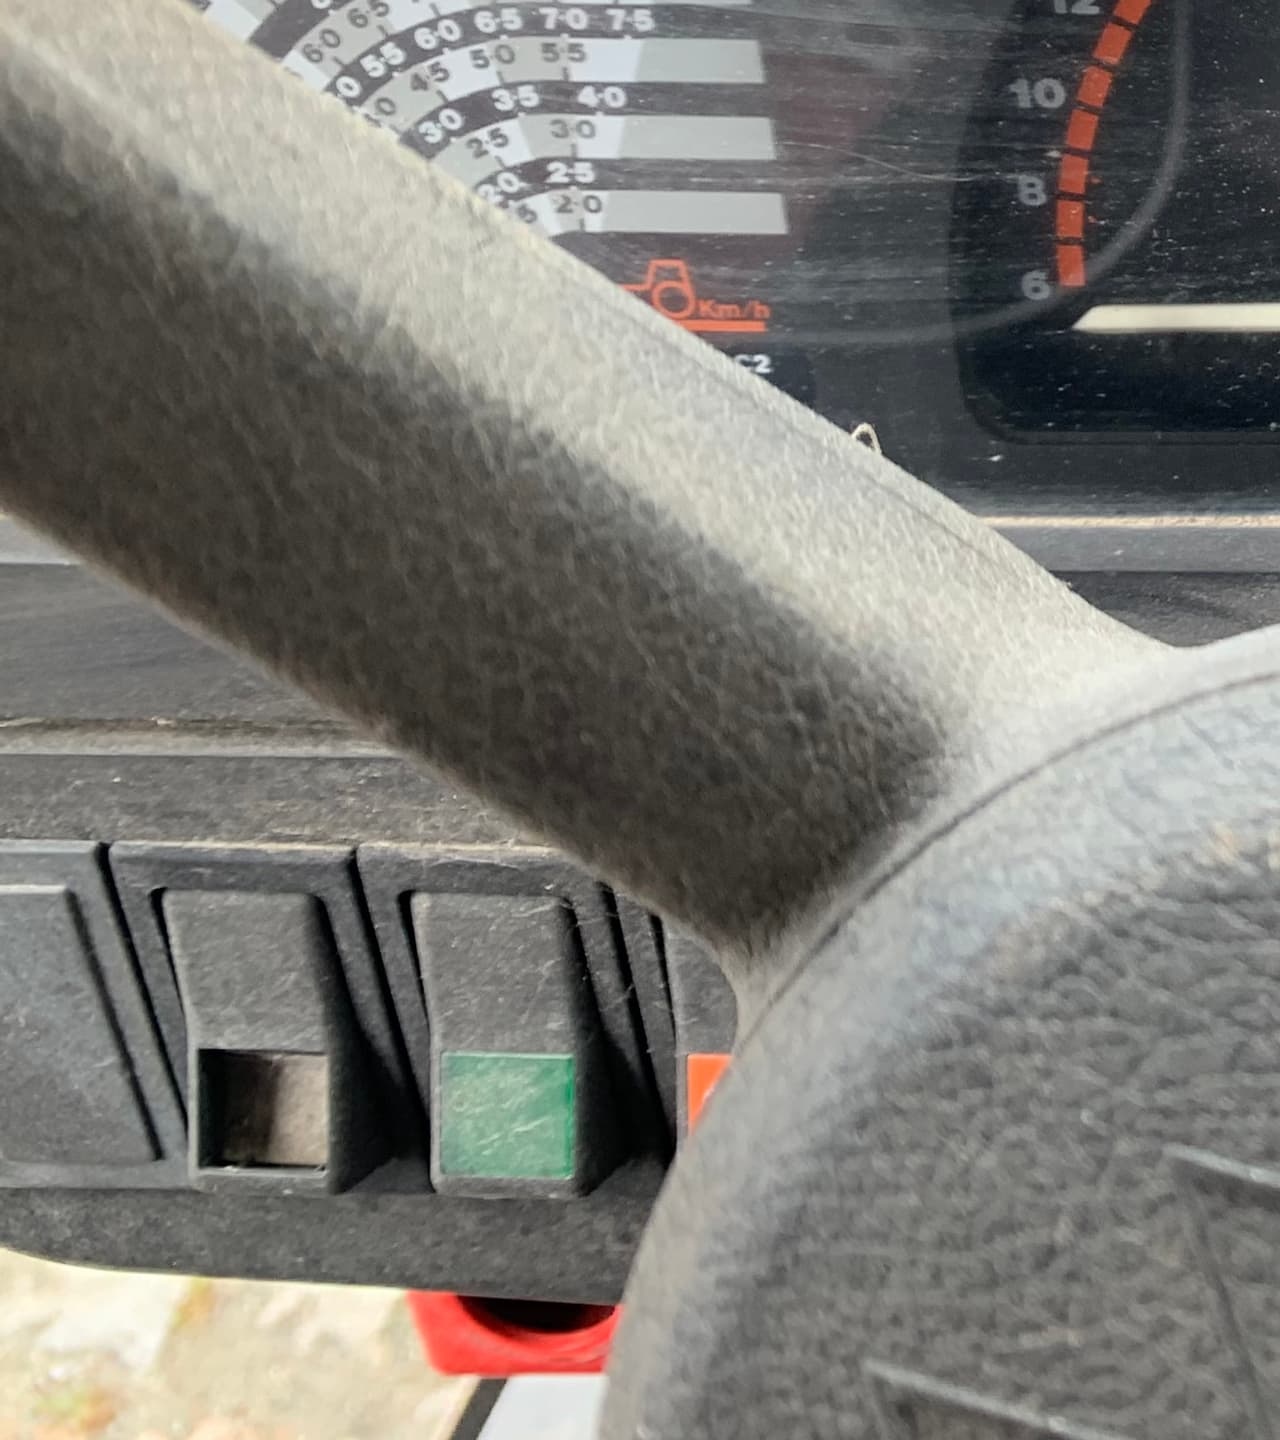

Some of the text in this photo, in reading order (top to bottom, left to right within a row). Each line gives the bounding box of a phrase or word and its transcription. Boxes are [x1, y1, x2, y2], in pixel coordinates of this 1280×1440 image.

[1009, 78, 1066, 108] 10
[1017, 175, 1047, 206] 8
[1021, 270, 1051, 301] 6
